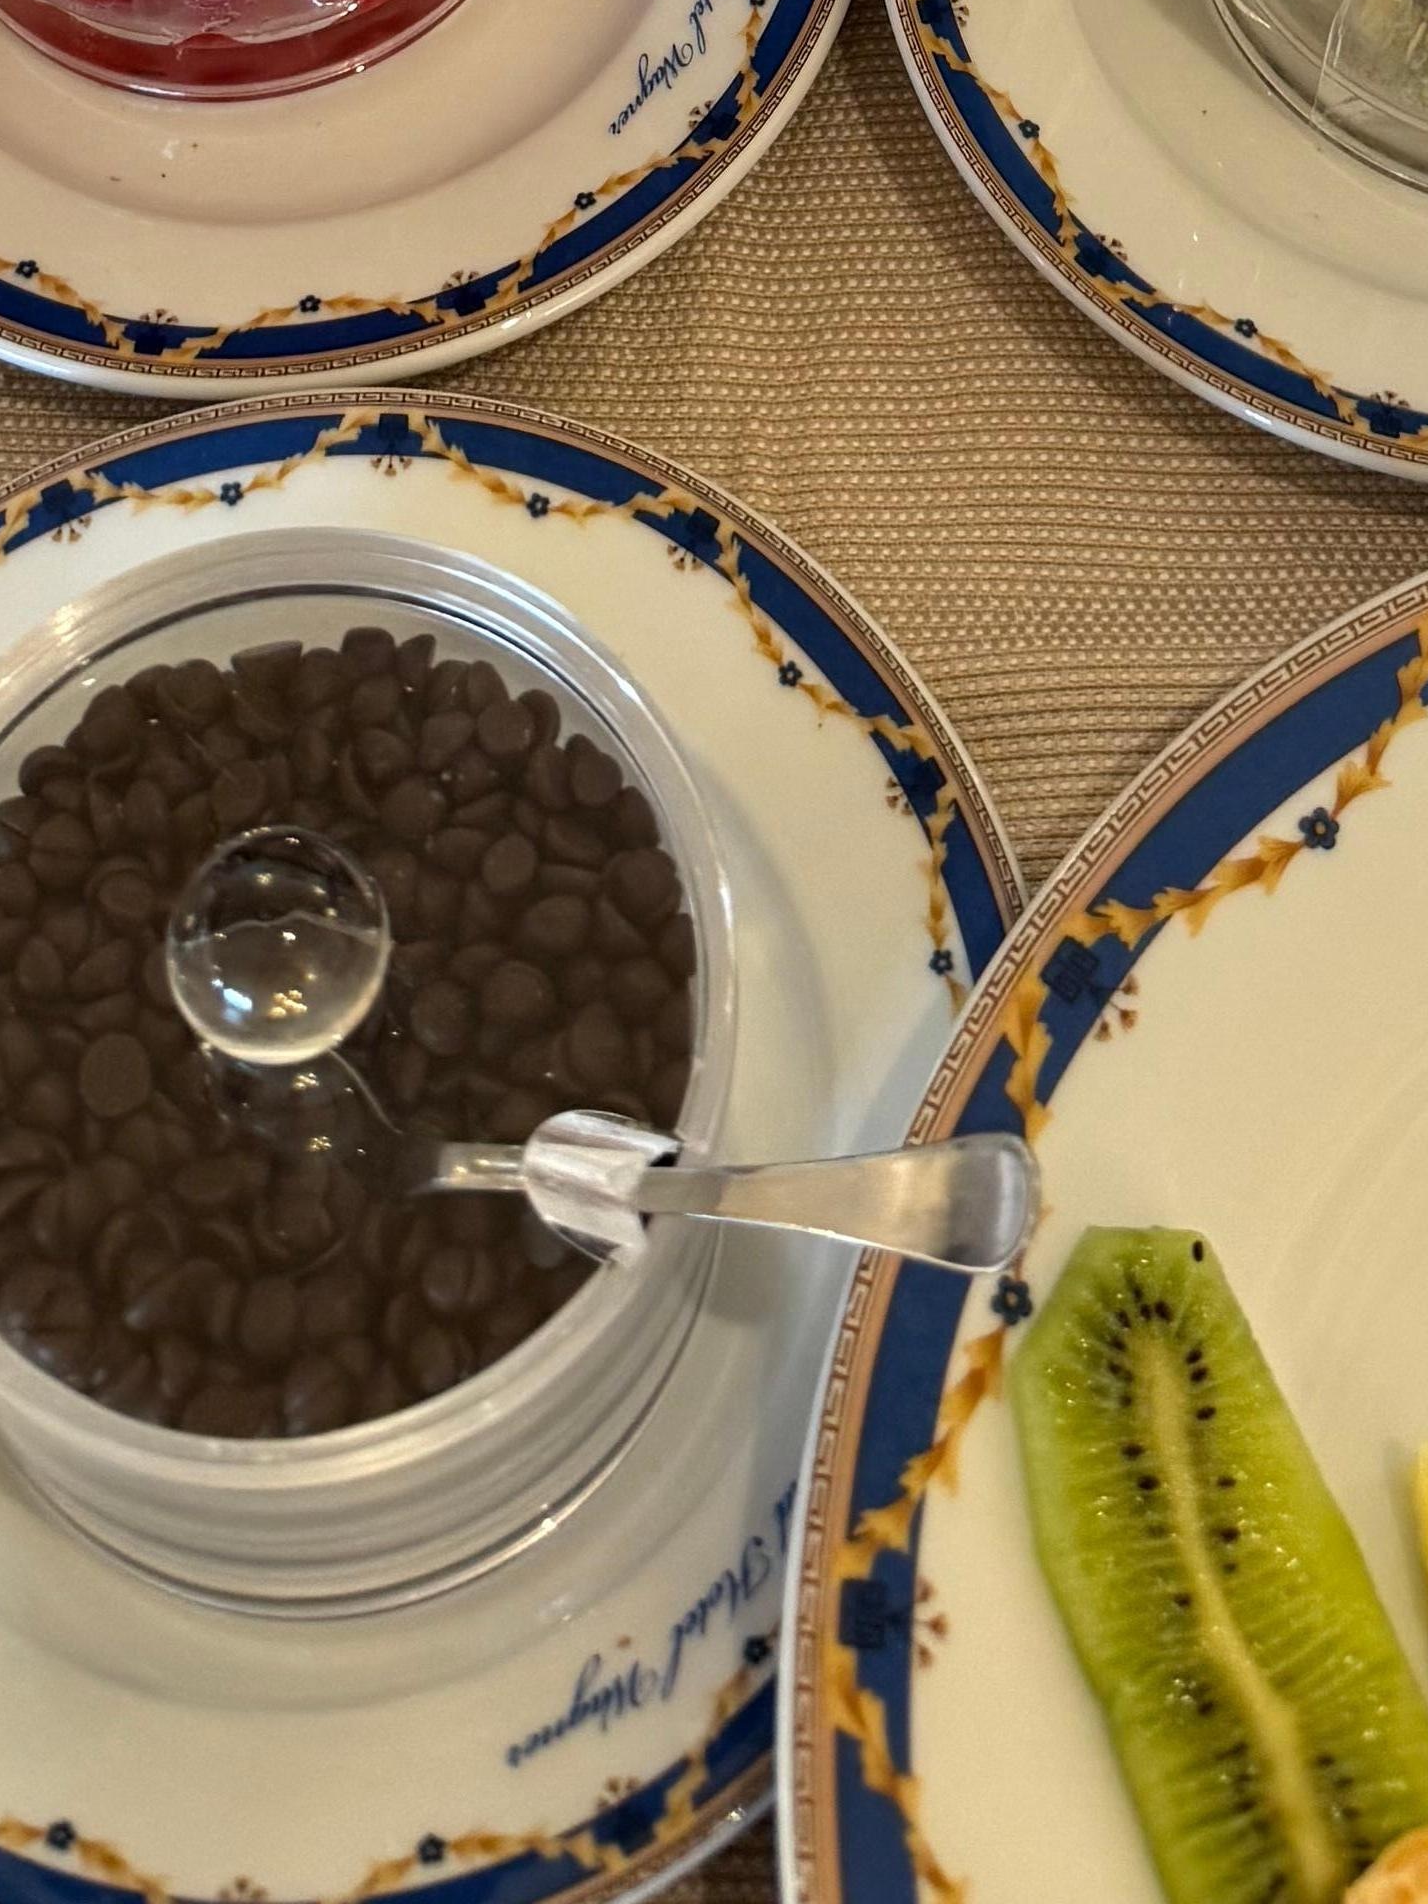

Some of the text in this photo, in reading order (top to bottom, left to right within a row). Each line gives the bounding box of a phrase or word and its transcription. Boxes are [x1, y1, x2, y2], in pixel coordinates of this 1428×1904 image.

[608, 42, 694, 136] Wagner
[506, 1536, 771, 1769] Hotel Wagner
